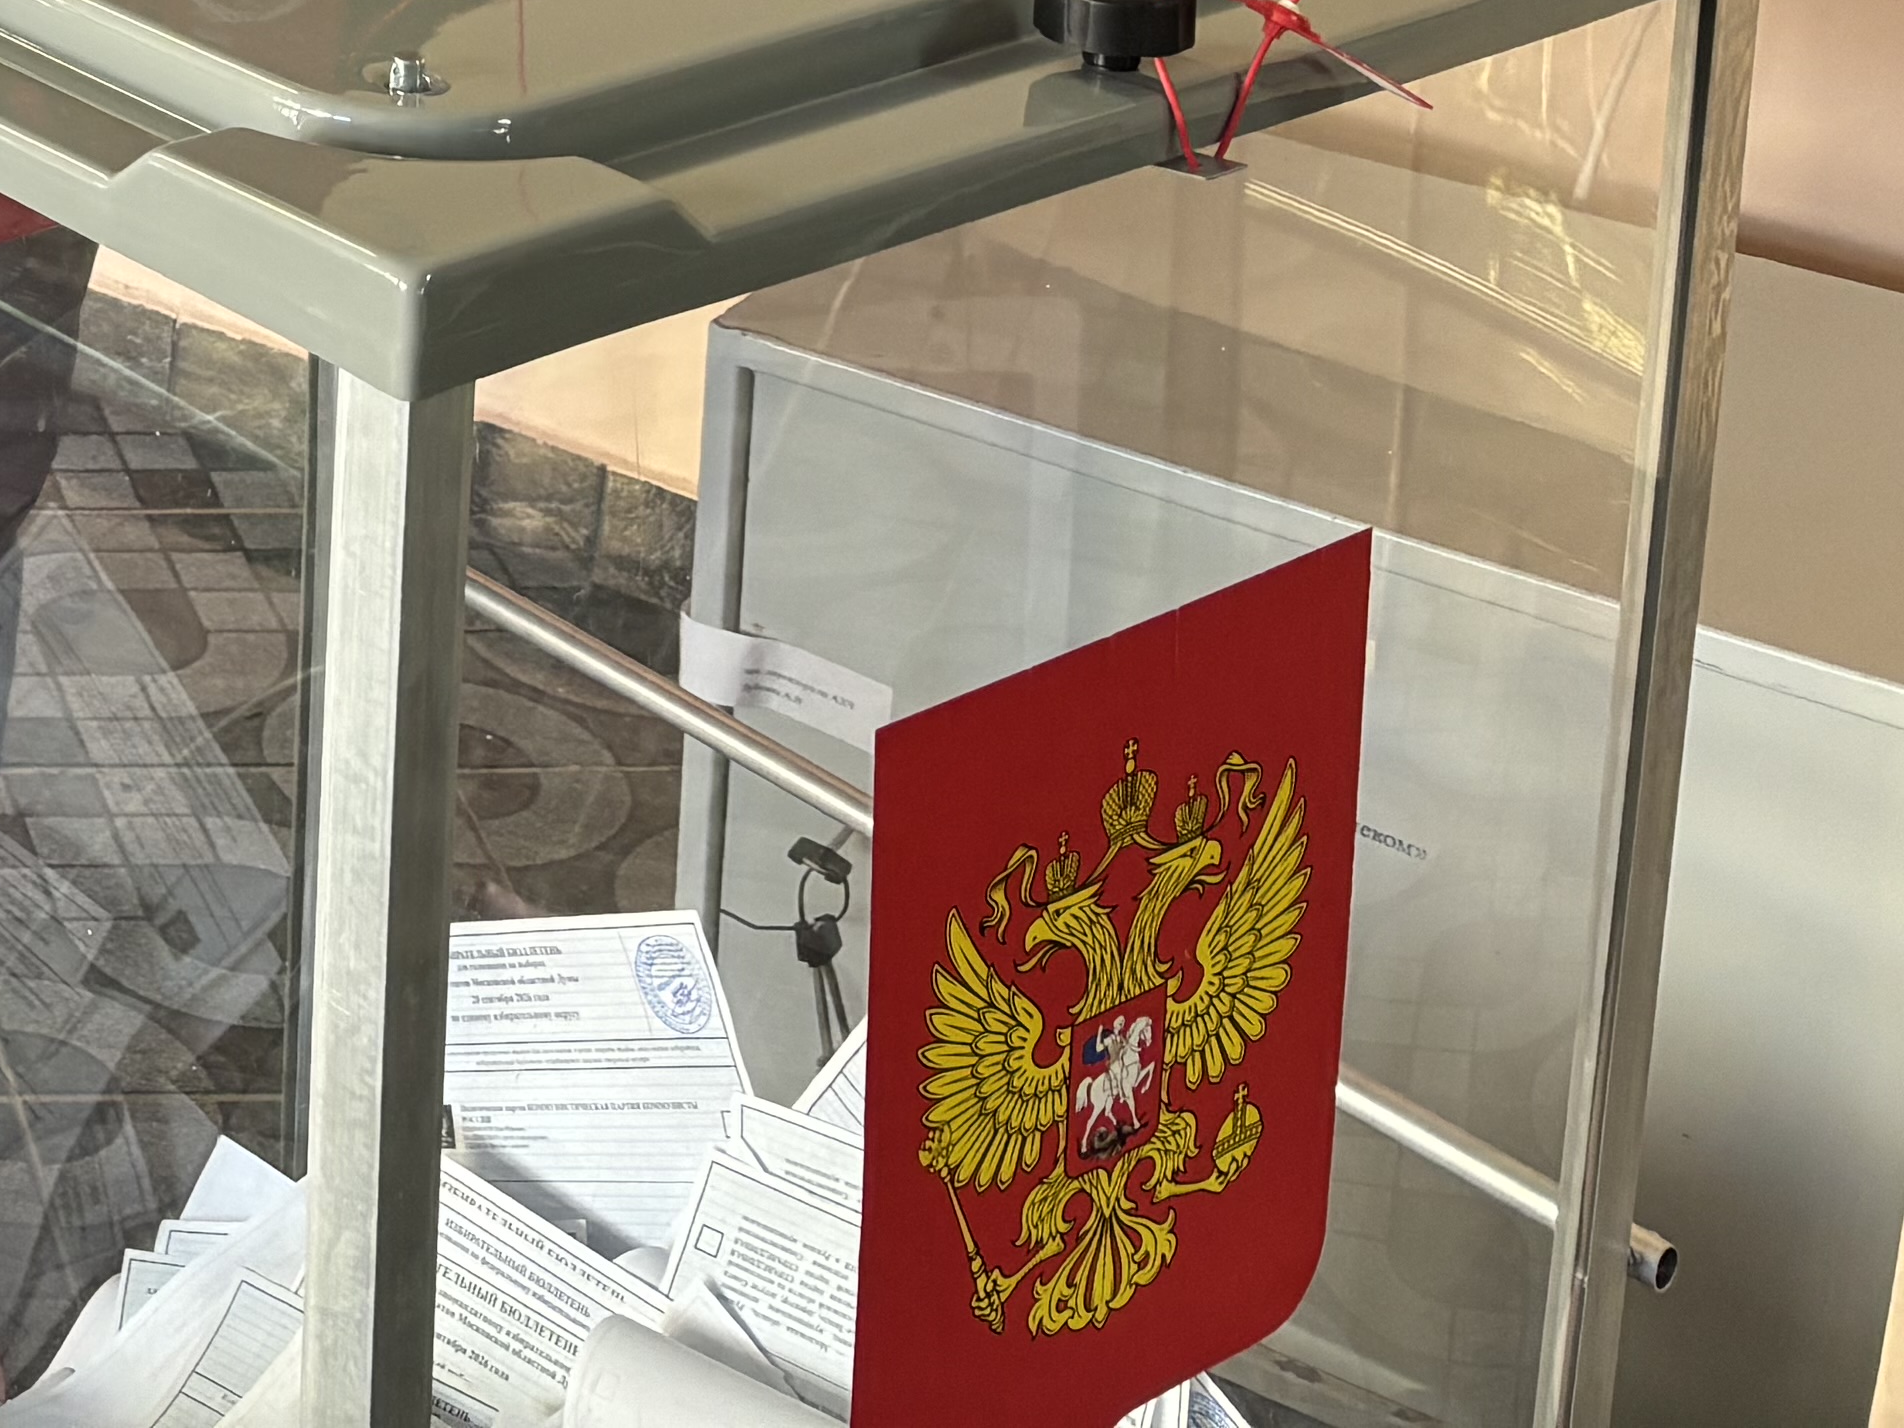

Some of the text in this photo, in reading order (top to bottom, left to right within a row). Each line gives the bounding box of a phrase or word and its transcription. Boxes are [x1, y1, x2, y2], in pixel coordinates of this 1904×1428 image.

[436, 1263, 499, 1308] ТЕЛЬНЫЙ
[444, 1218, 591, 1319] ИЗБИРАТЕЛЬНЫЙ БЮЛЛЕТЕНЬ
